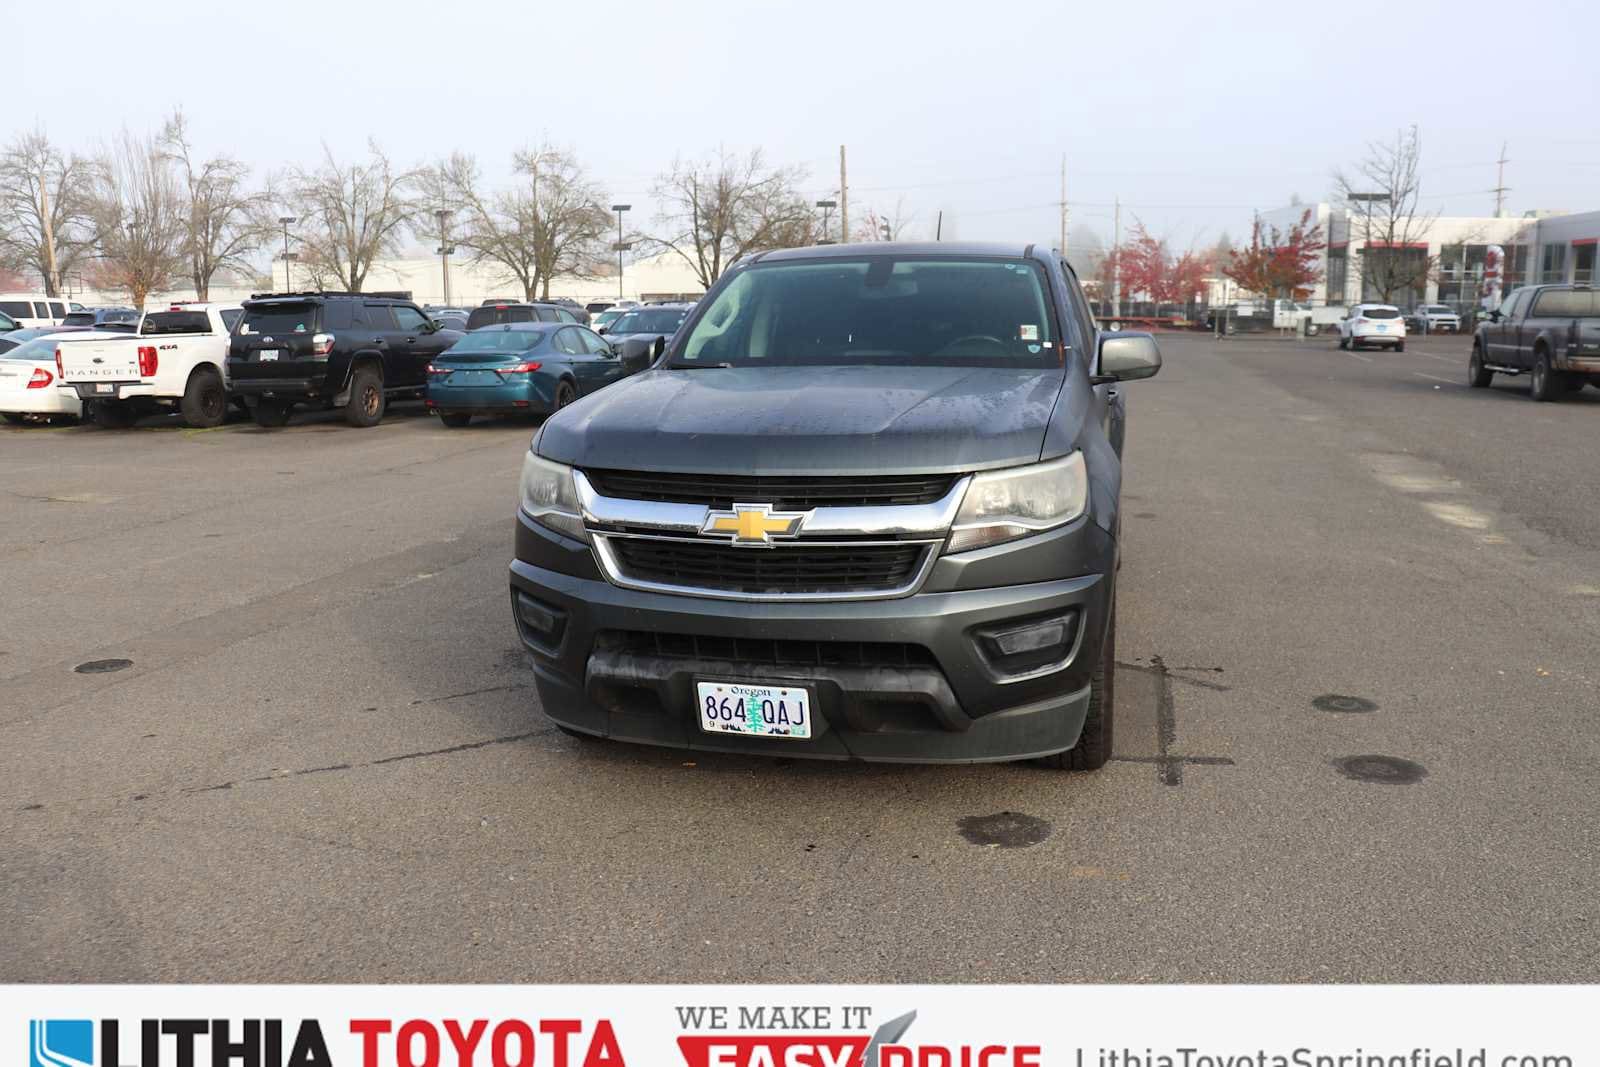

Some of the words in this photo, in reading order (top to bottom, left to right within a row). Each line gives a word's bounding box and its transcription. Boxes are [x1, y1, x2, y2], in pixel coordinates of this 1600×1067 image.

[65, 368, 138, 376] RANGER
[731, 686, 771, 697] Oregon
[706, 695, 746, 722] 864
[762, 699, 804, 726] QAJ
